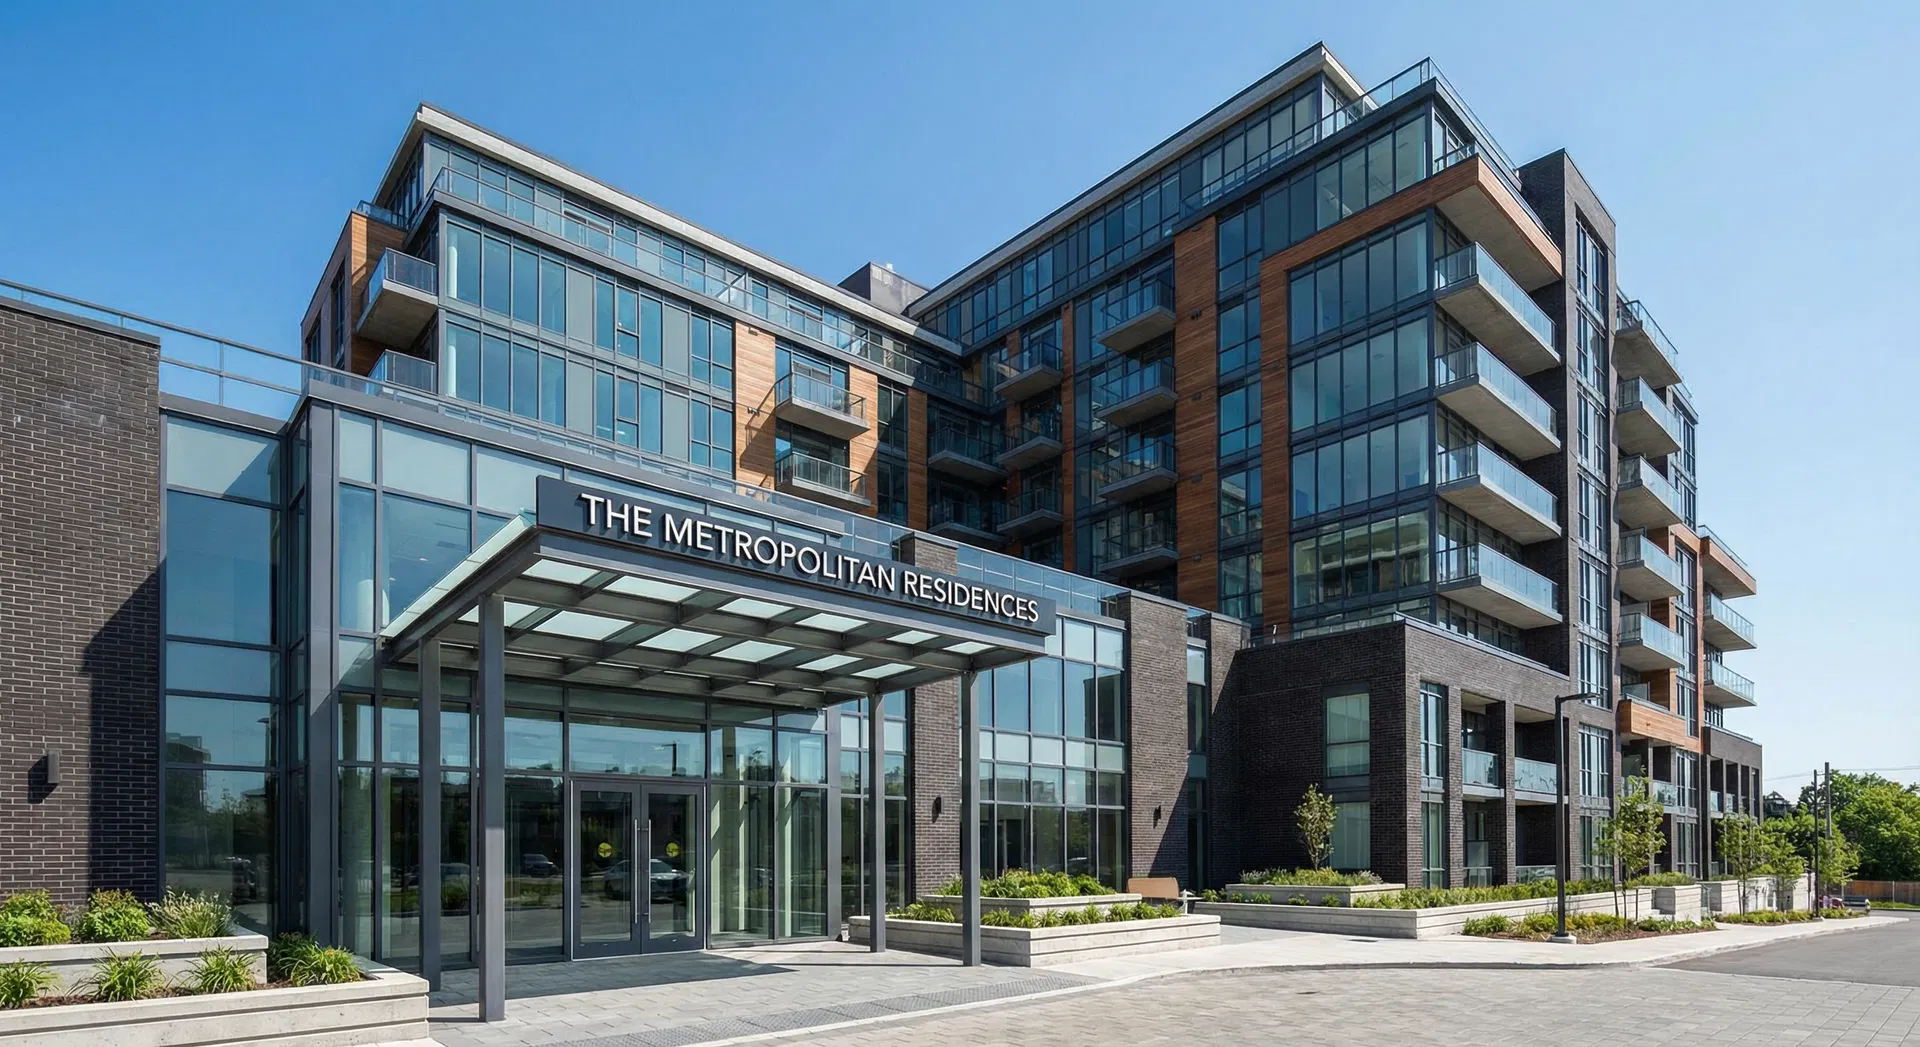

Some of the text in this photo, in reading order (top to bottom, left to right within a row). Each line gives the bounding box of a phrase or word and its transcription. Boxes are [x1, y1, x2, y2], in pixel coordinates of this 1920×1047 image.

[581, 493, 1039, 623] THE METROPOLITAN RESIDENCES
